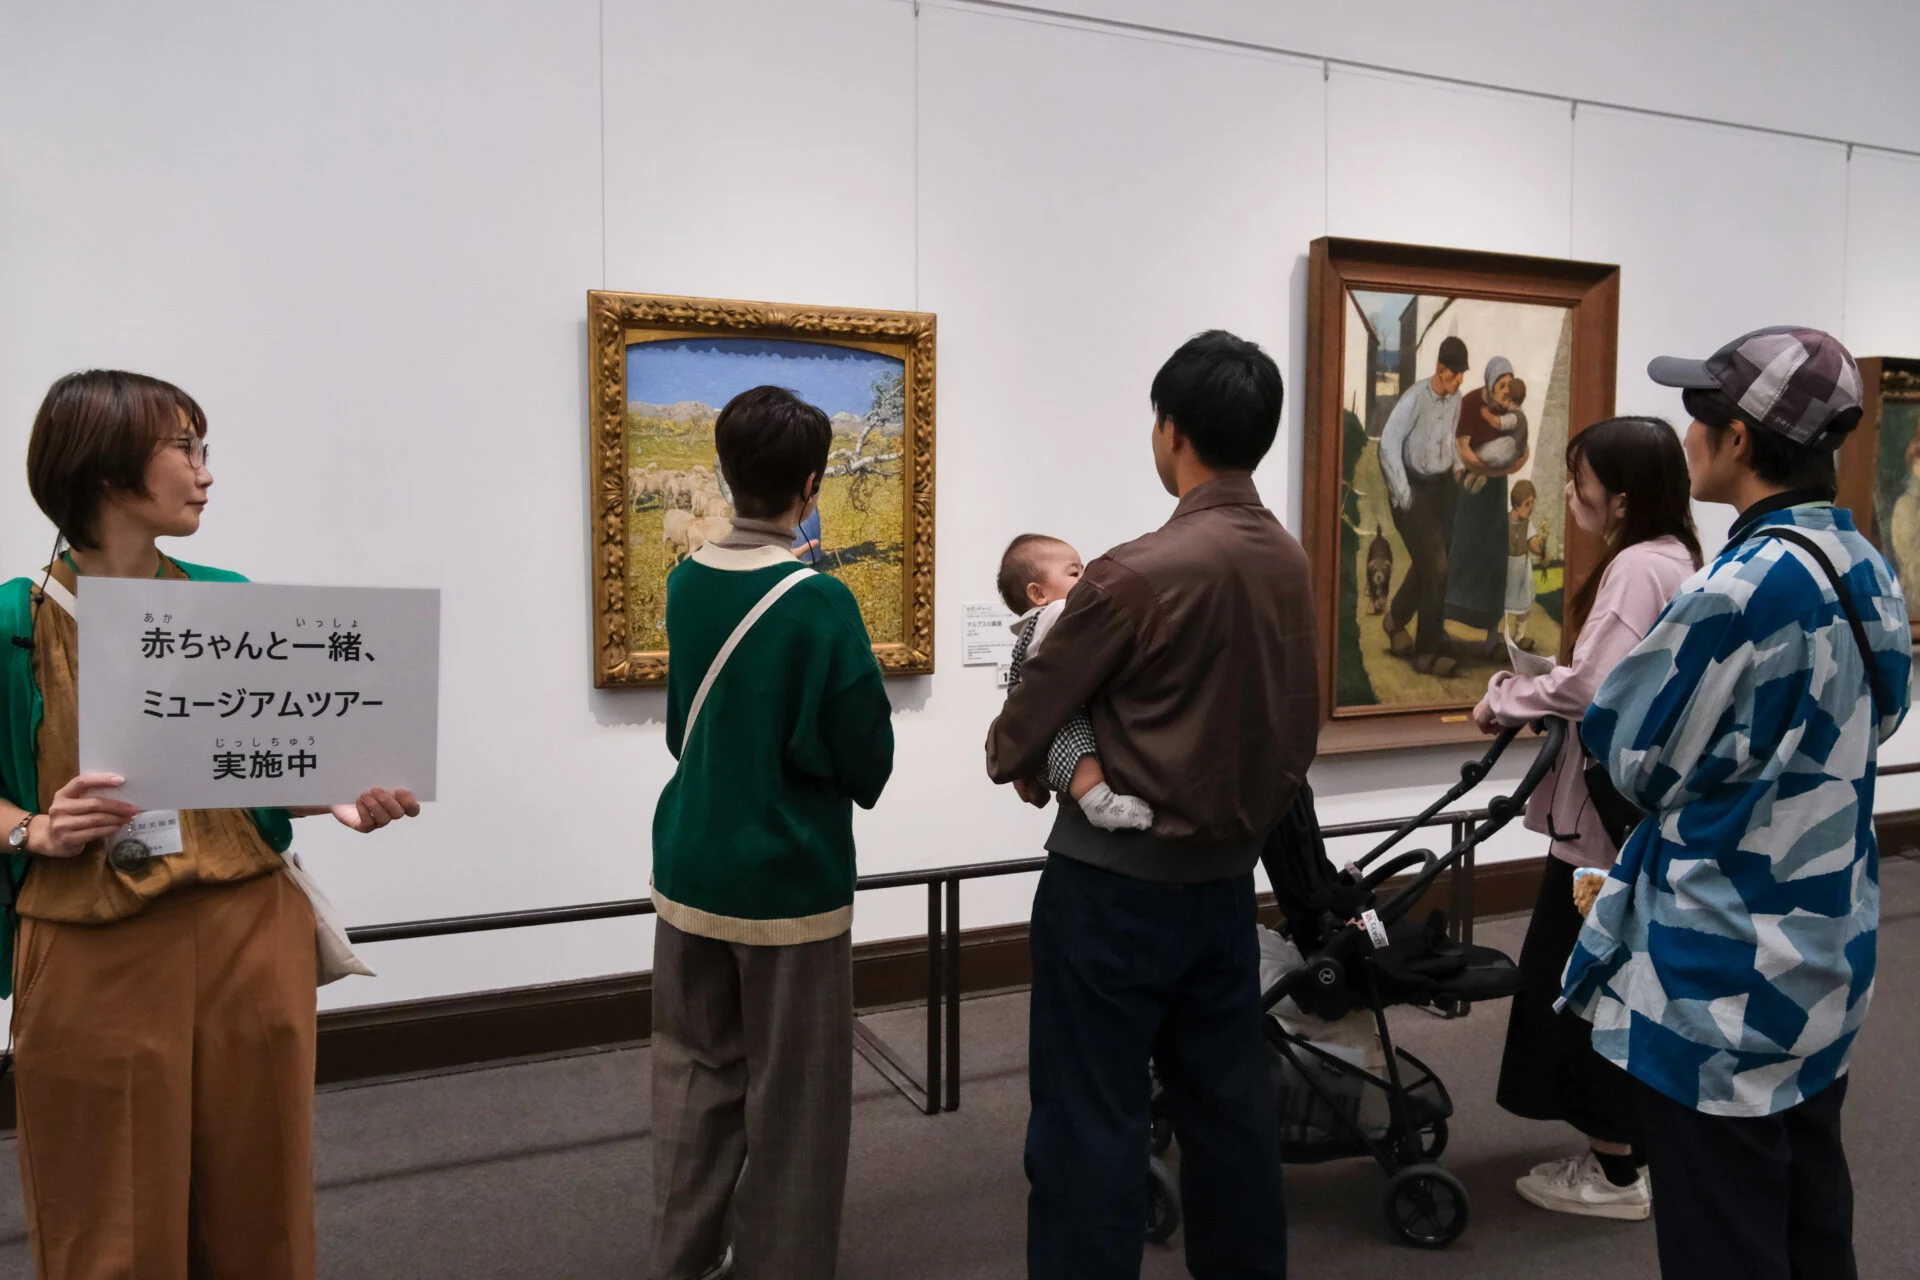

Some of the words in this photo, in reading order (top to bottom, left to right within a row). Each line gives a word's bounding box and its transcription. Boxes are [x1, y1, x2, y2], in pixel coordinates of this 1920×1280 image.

[143, 613, 173, 624] あか
[296, 618, 359, 627] いっしょ
[141, 627, 376, 662] 赤ちゃんと一緒、
[143, 688, 383, 719] ミュージアムツアー
[215, 736, 316, 748] じっしちゅう
[212, 749, 318, 780] 実施中
